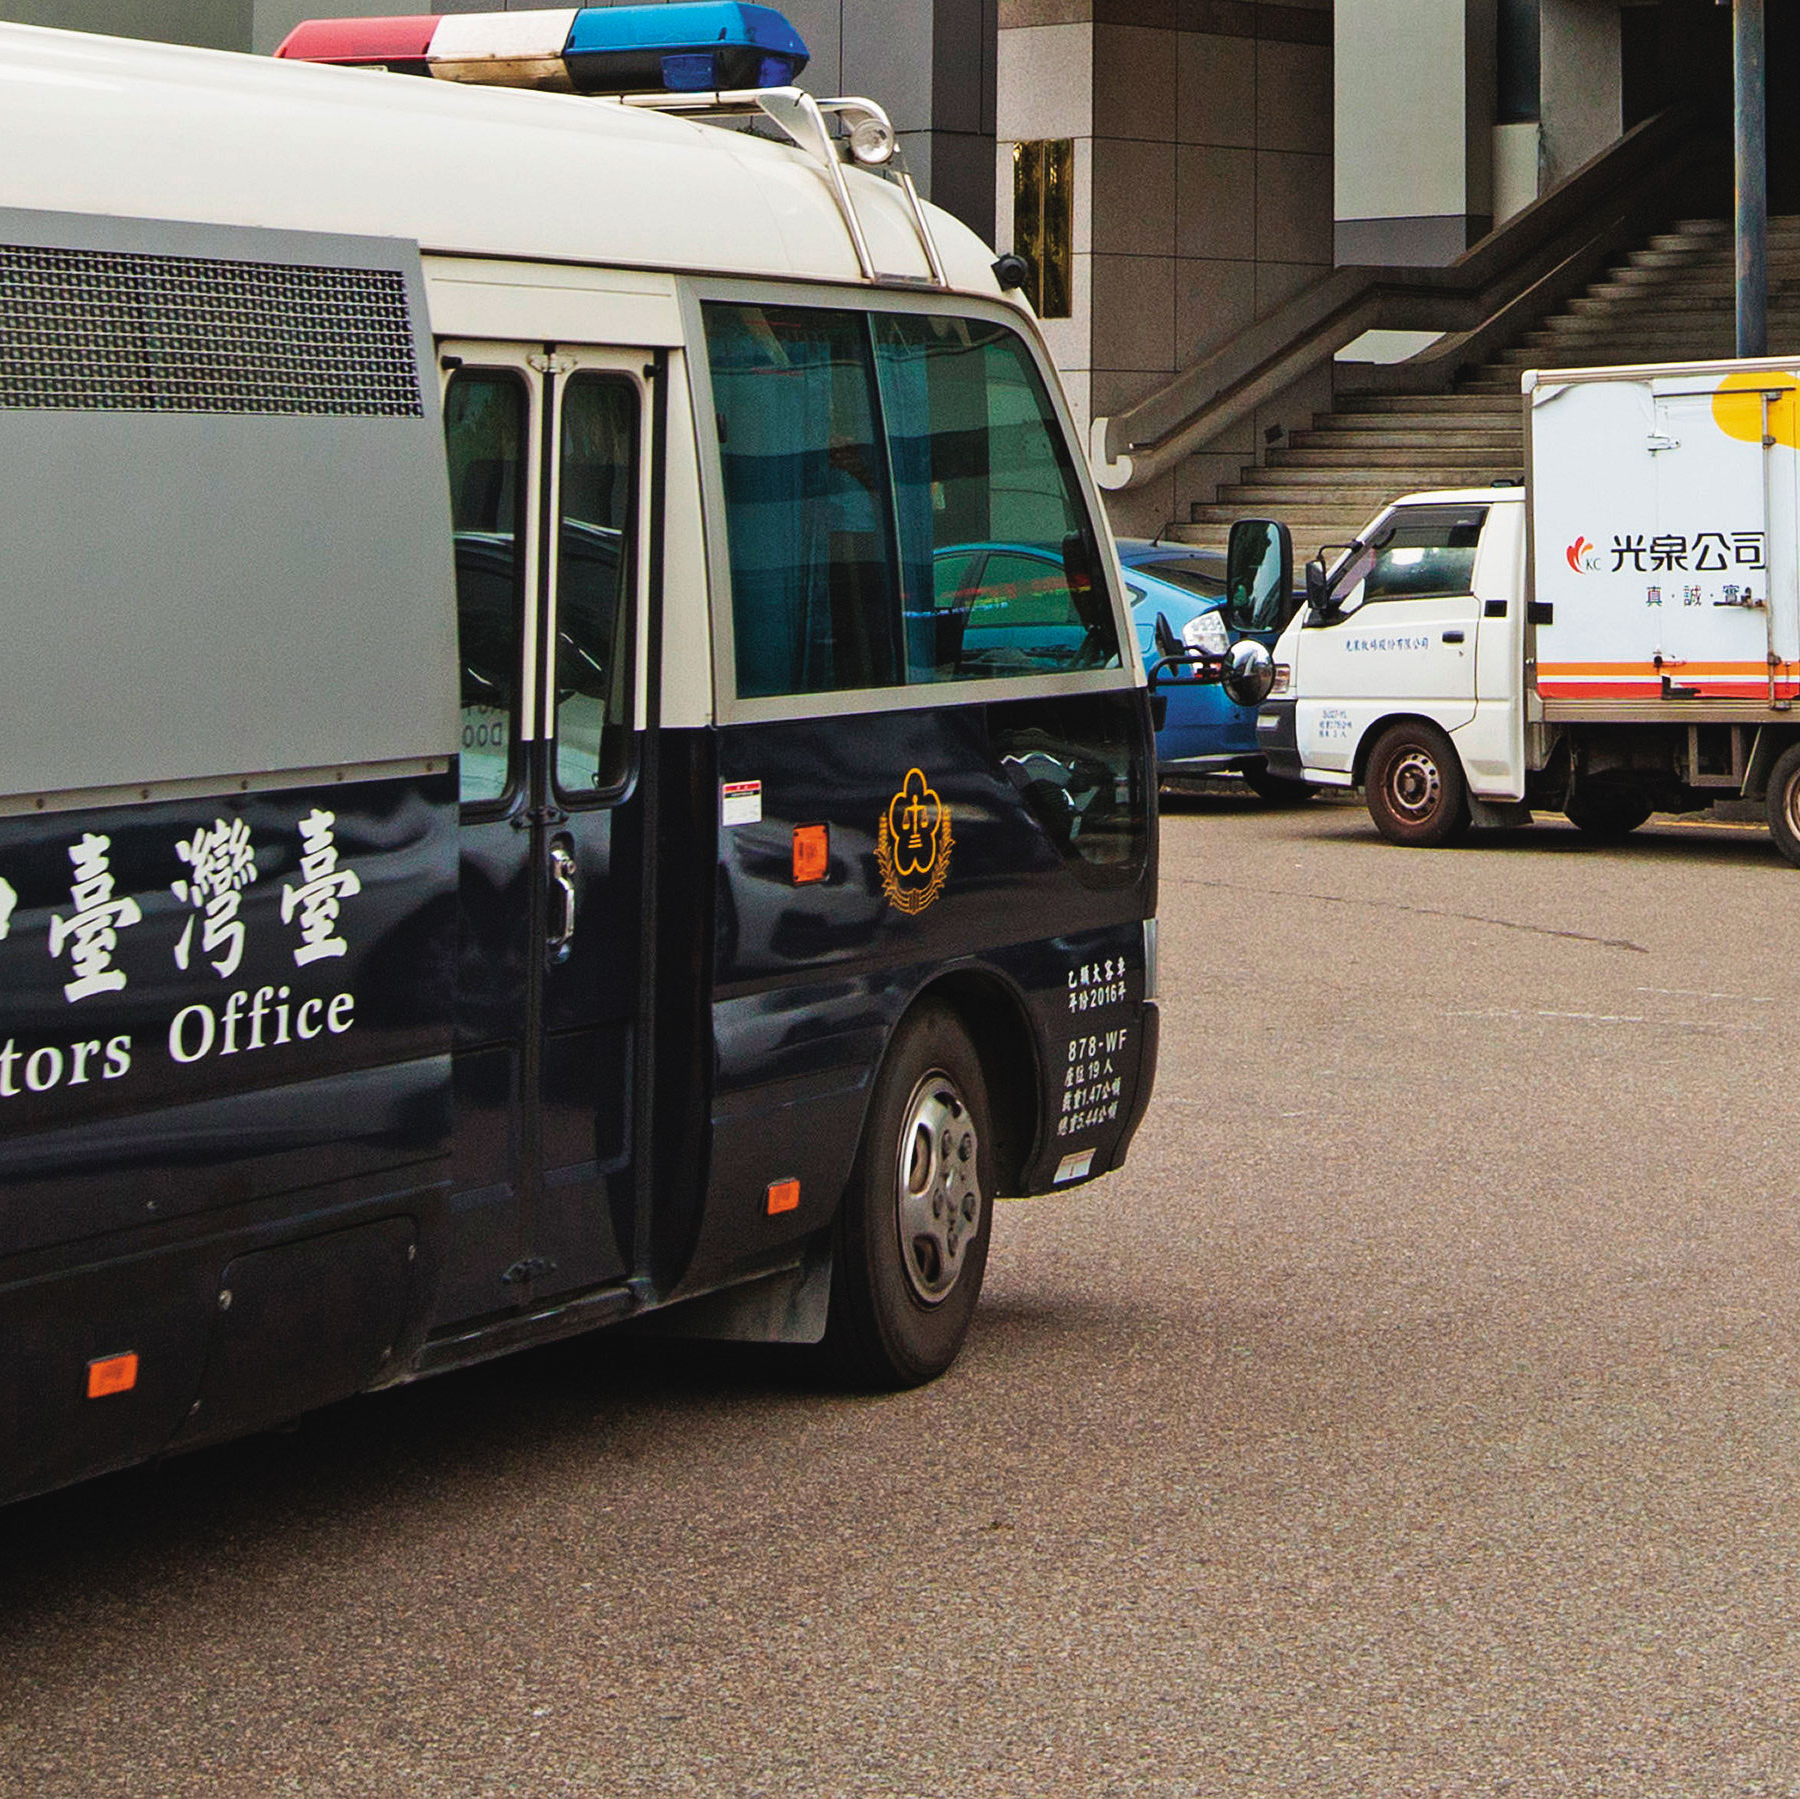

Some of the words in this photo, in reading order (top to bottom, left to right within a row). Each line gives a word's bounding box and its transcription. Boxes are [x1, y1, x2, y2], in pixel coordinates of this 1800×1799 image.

[1585, 557, 1601, 571] KC
[1610, 532, 1767, 572] 光泉公司
[168, 981, 359, 1066] Office
[1068, 1029, 1128, 1062] 878-WF
